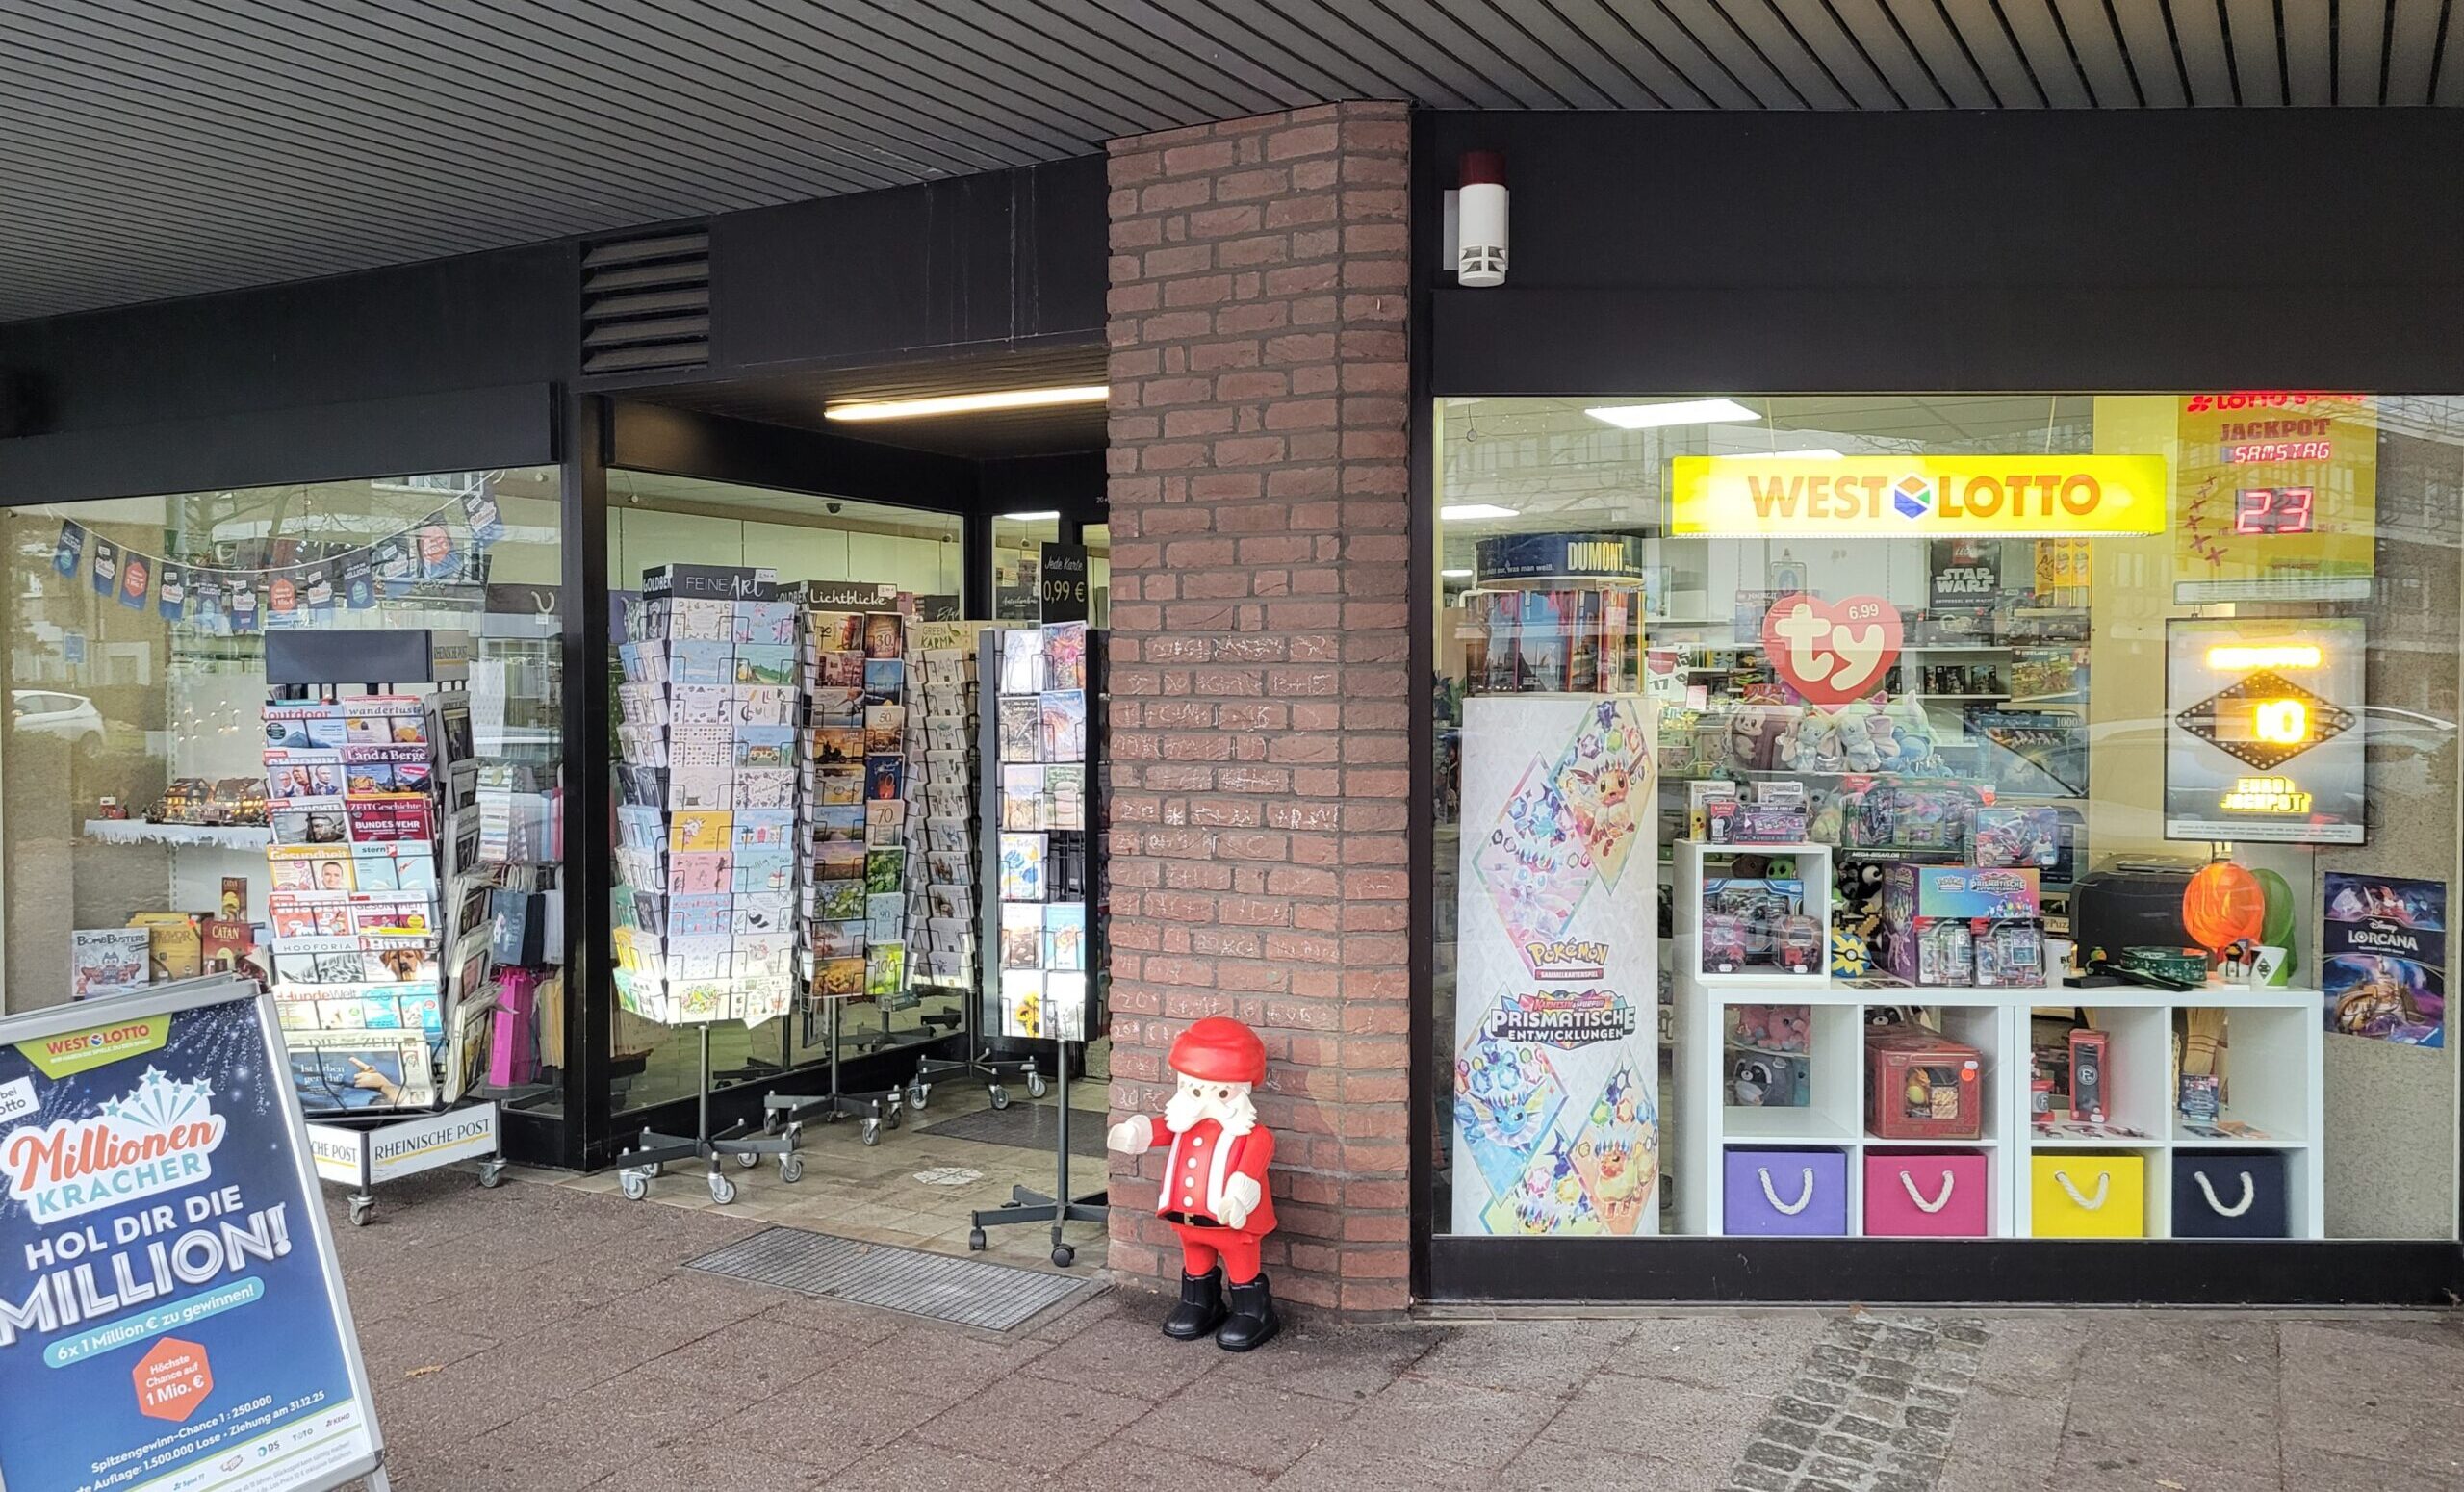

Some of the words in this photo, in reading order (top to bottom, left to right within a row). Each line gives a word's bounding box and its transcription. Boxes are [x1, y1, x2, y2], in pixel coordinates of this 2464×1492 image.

[2220, 418, 2331, 442] JACKPOT
[2234, 442, 2331, 463] SAMSTAG
[1747, 475, 1887, 518] WEST
[1938, 473, 2102, 518] LOTTO
[2236, 490, 2312, 534] 23
[1567, 542, 1625, 572] DUMONT
[643, 576, 673, 593] GOLDBEK
[685, 577, 732, 592] FEINE
[1936, 567, 1995, 580] STAR
[810, 587, 887, 605] Lichtblicke
[1043, 580, 1070, 604] 0,99
[1074, 581, 1085, 603] €
[1936, 579, 1995, 593] WARS
[1848, 603, 1880, 620] 6.99
[920, 634, 957, 649] KARMA
[922, 626, 947, 635] GREEN
[1774, 603, 1885, 691] ty
[269, 708, 332, 719] outdoor
[2056, 716, 2079, 727] 1000
[347, 749, 382, 761] Land
[390, 749, 425, 762] Berge
[77, 935, 107, 946] BOMB
[107, 934, 146, 945] BUSTERS
[212, 925, 240, 939] CATAN
[2348, 929, 2419, 951] LORCANA
[283, 942, 352, 952] HOOFORIA
[1526, 936, 1609, 967] Pokémon
[1491, 1006, 1636, 1033] PRISMATISCHE
[46, 1035, 90, 1055] WEST
[102, 1024, 150, 1044] LOTTO
[308, 1038, 339, 1048] DIE
[362, 1037, 398, 1048] ZEIT
[1508, 1027, 1624, 1041] ENTWICKLUNGEN
[299, 1064, 313, 1073] Ist
[373, 1126, 454, 1161] RHEINISCHE
[457, 1118, 492, 1139] POST
[9, 1117, 219, 1192] Millionen
[331, 1144, 358, 1164] POST
[36, 1152, 204, 1217] KRACHER
[25, 1228, 108, 1271] HOL
[115, 1203, 178, 1246] DIR
[186, 1184, 244, 1222] DIE
[0, 1201, 293, 1346] MILLION!
[57, 1341, 79, 1362] 6x
[80, 1338, 90, 1355] 1
[93, 1321, 145, 1351] Million
[145, 1315, 160, 1331] €
[162, 1309, 183, 1329] zu
[183, 1283, 255, 1324] gewinnen!
[145, 1370, 183, 1389] Chance
[183, 1362, 199, 1376] auf
[149, 1353, 191, 1376] Höchste
[145, 1391, 154, 1406] 1
[157, 1383, 192, 1403] Mio.
[192, 1374, 205, 1389] €
[90, 1412, 218, 1475] Spitzengewinn-Chance
[231, 1394, 273, 1419] 250.000
[94, 1465, 143, 1491] Auflage:
[142, 1443, 195, 1471] 1.500.000
[195, 1433, 222, 1451] Lose
[228, 1413, 272, 1437] Ziehung
[272, 1407, 290, 1420] am
[289, 1390, 326, 1413] 31.12.25
[292, 1428, 314, 1441] TOTO
